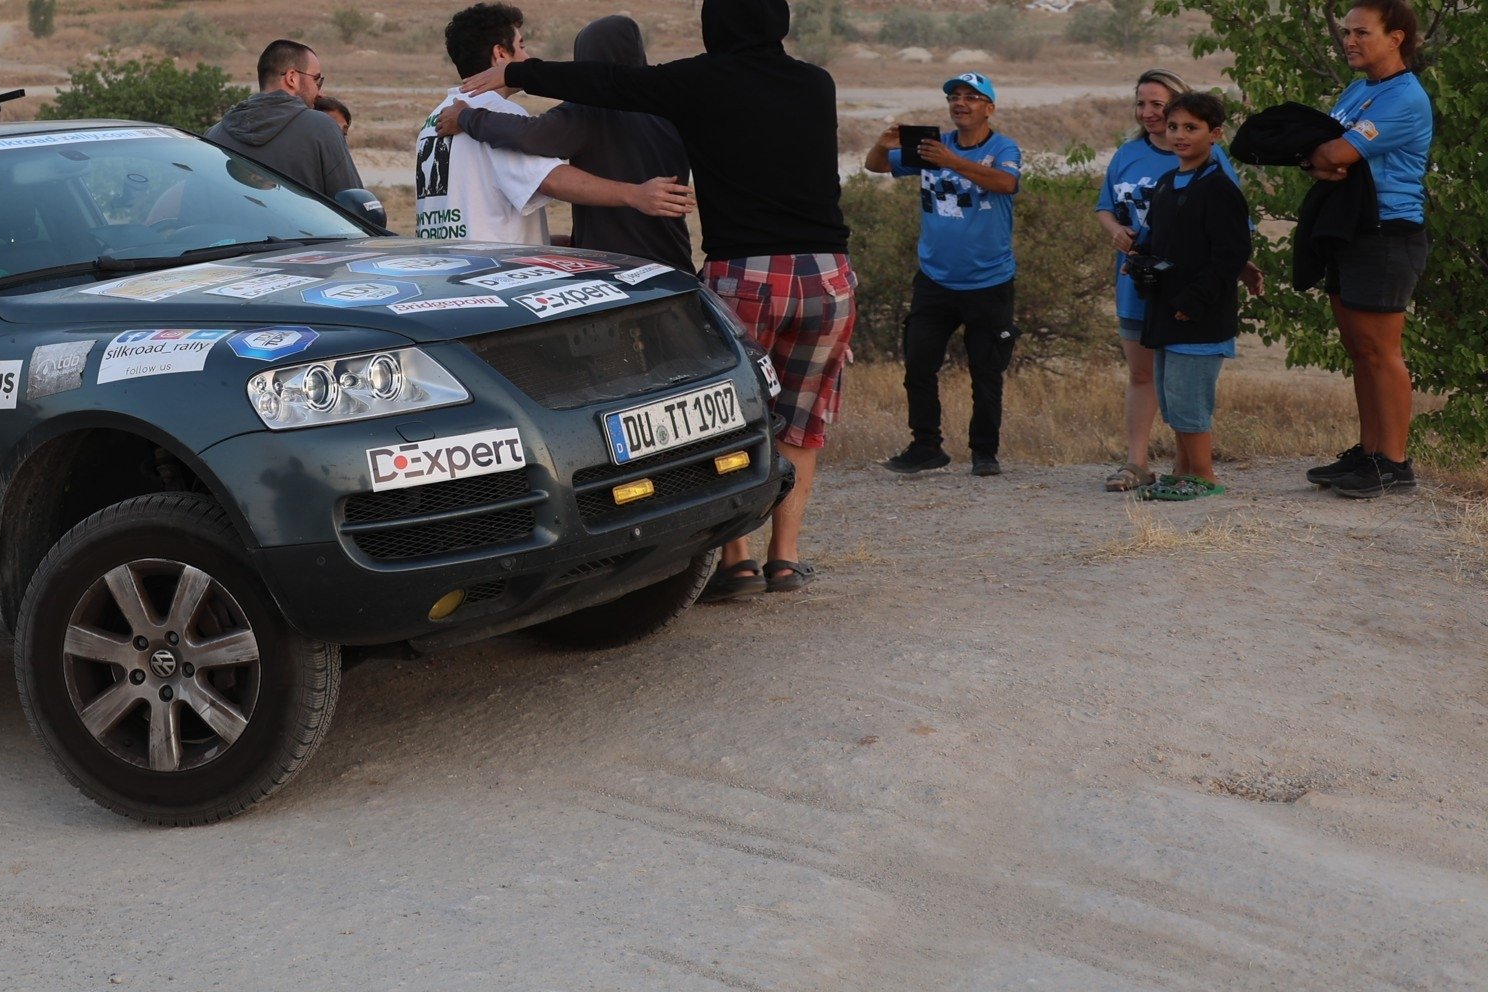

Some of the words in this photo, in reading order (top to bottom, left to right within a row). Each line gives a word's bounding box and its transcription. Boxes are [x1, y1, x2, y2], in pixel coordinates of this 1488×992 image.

[396, 296, 500, 311] Bridgepoint
[105, 341, 211, 361] silkroad_rally
[125, 363, 157, 376] follow
[160, 362, 172, 372] us
[622, 411, 656, 453] DU
[664, 400, 692, 439] TT
[693, 387, 736, 433] 1907
